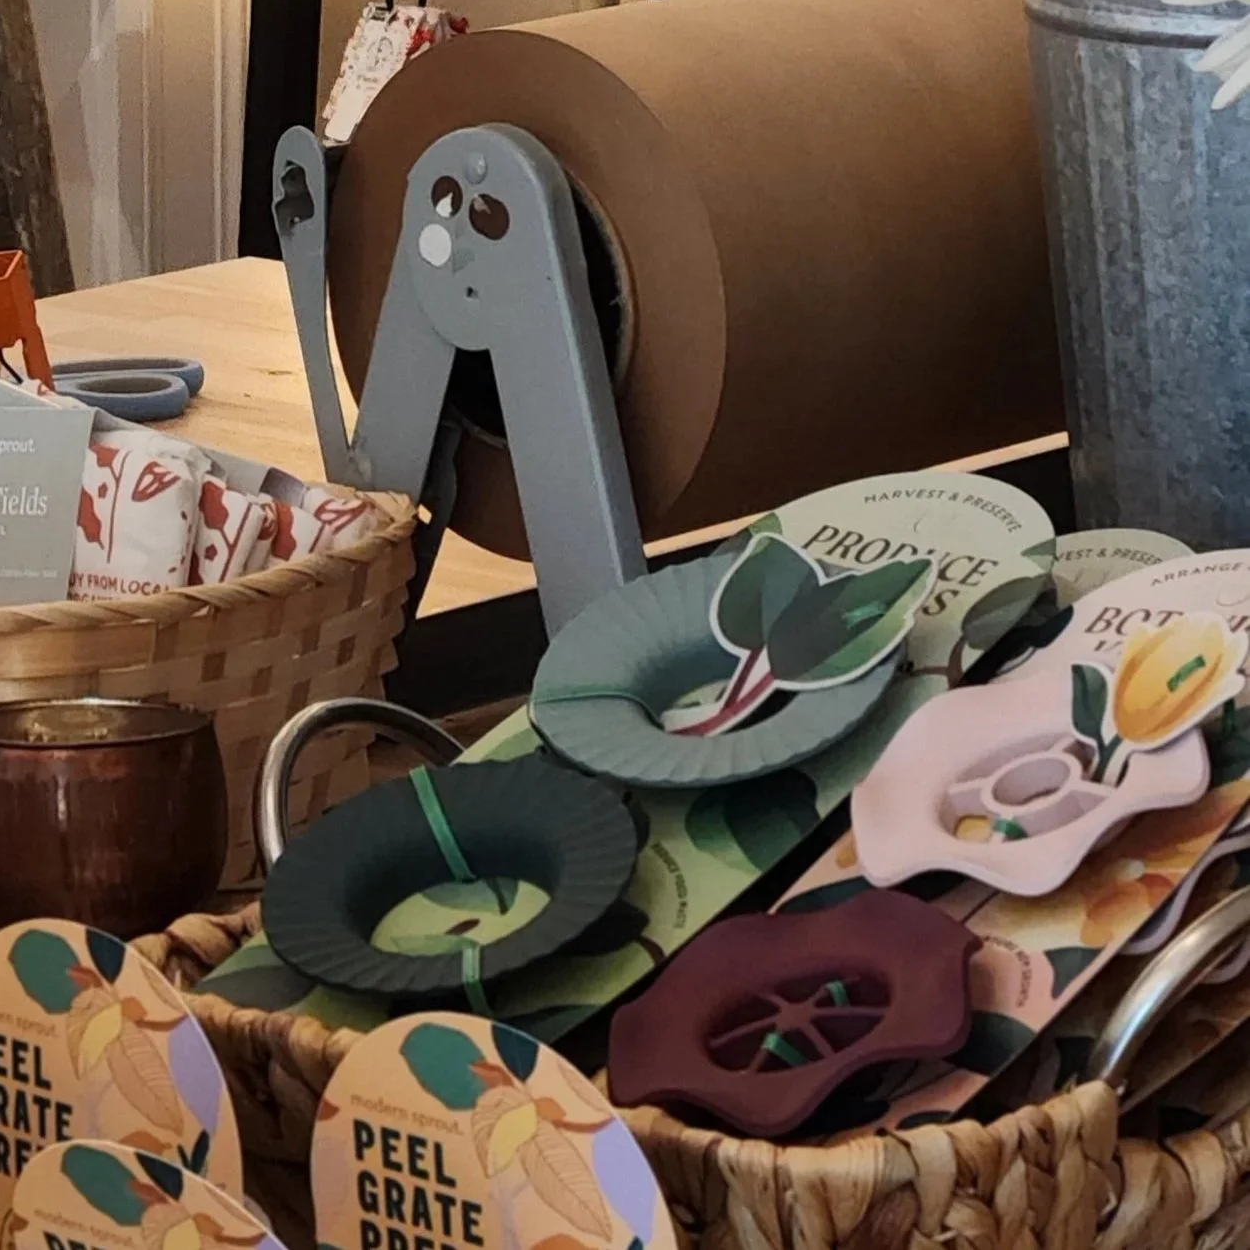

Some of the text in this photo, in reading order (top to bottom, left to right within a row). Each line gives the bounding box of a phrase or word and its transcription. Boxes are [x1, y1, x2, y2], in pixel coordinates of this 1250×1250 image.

[863, 488, 947, 504] HARVEST
[962, 494, 1023, 534] PRESERVE
[1151, 560, 1245, 586] ARRANGE
[353, 1117, 457, 1189] PEEL
[357, 1169, 485, 1249] GRATE
